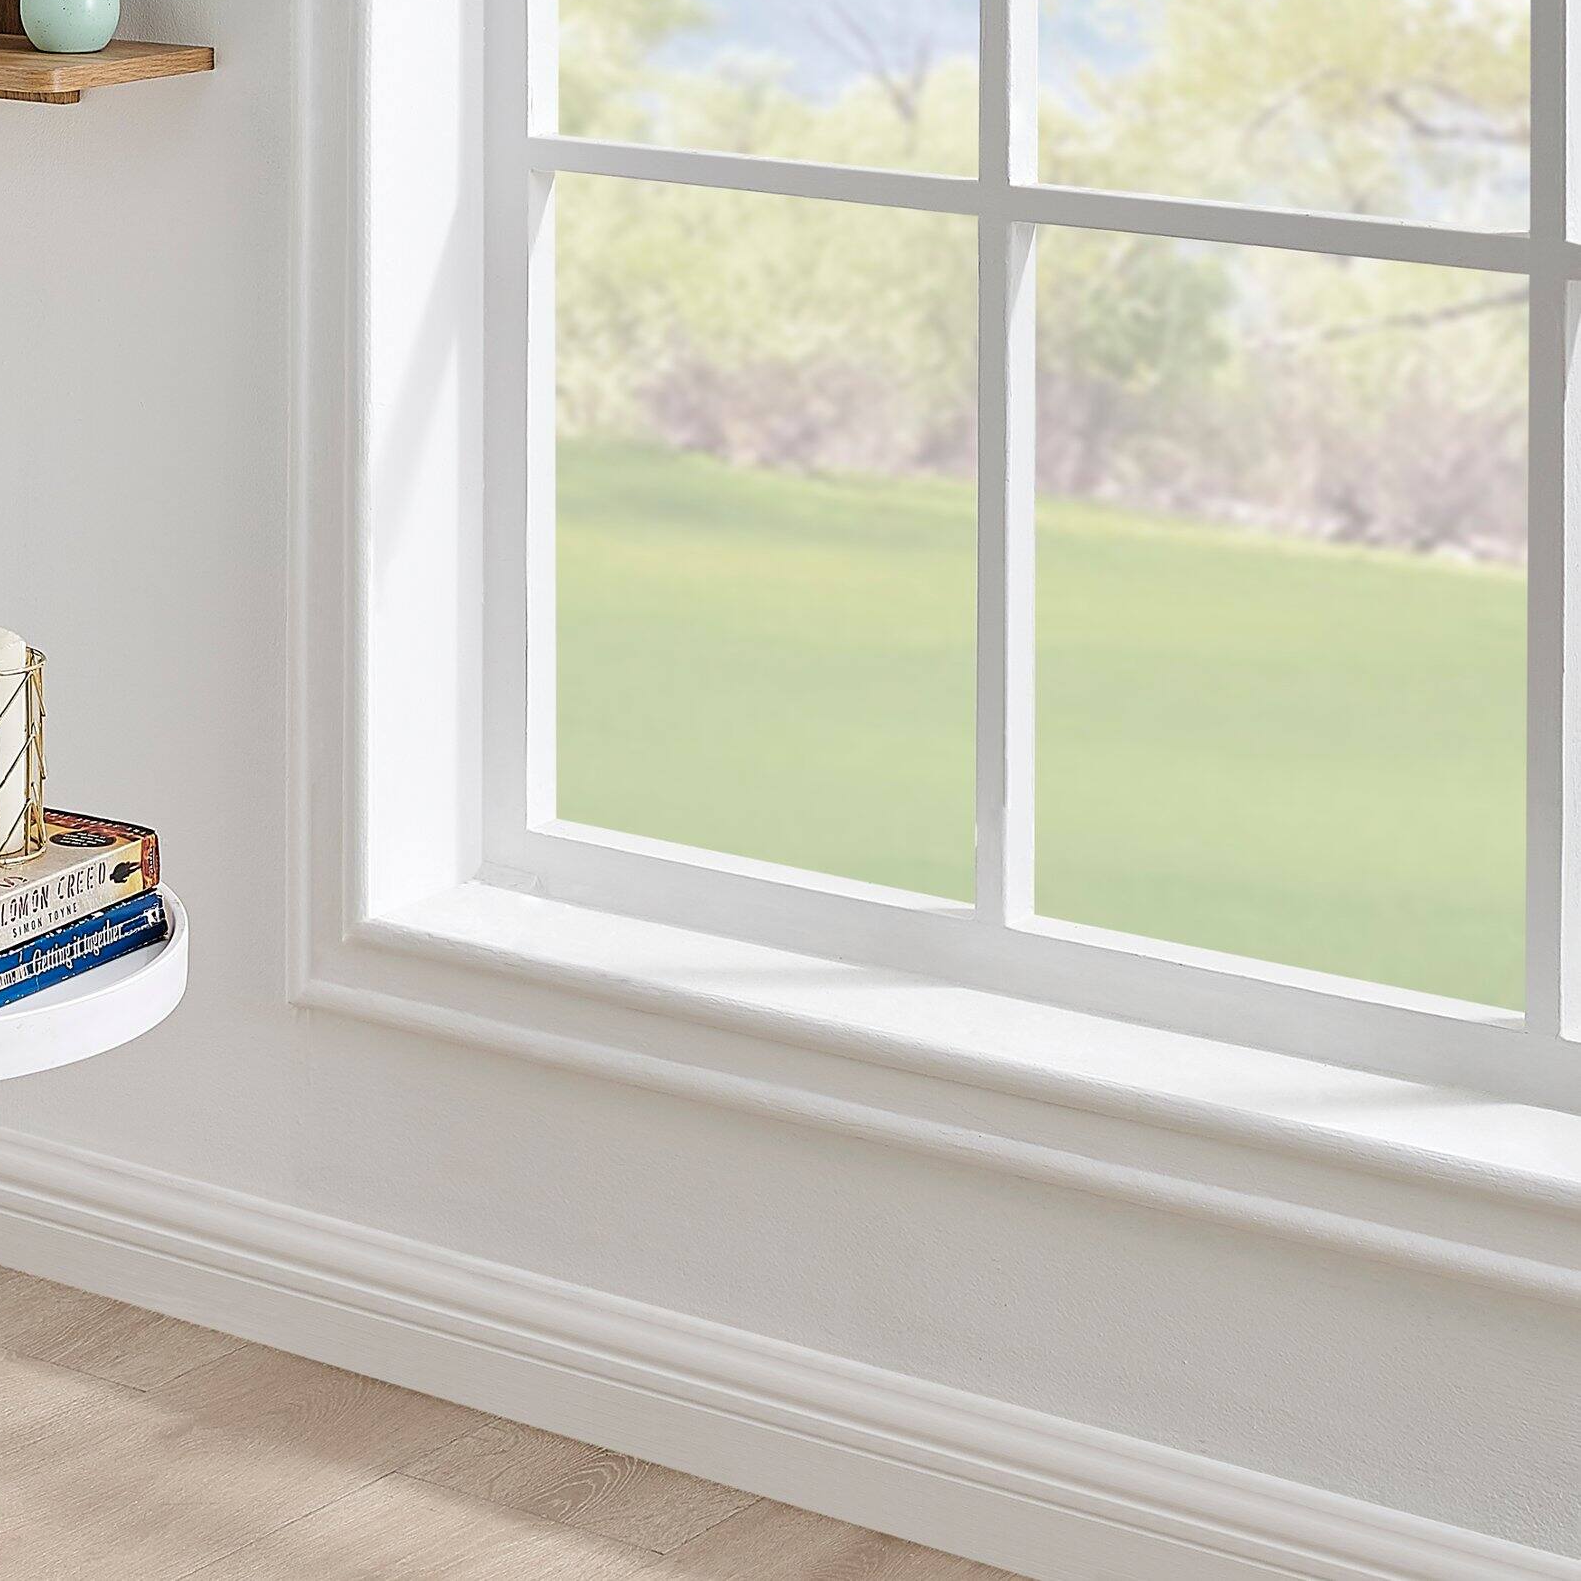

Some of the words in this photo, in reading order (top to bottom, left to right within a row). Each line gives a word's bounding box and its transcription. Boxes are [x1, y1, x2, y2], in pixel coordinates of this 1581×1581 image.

[58, 862, 107, 900] CREED
[12, 918, 42, 938] SIMON
[48, 902, 78, 923] TOYNE
[33, 943, 74, 970] Getting
